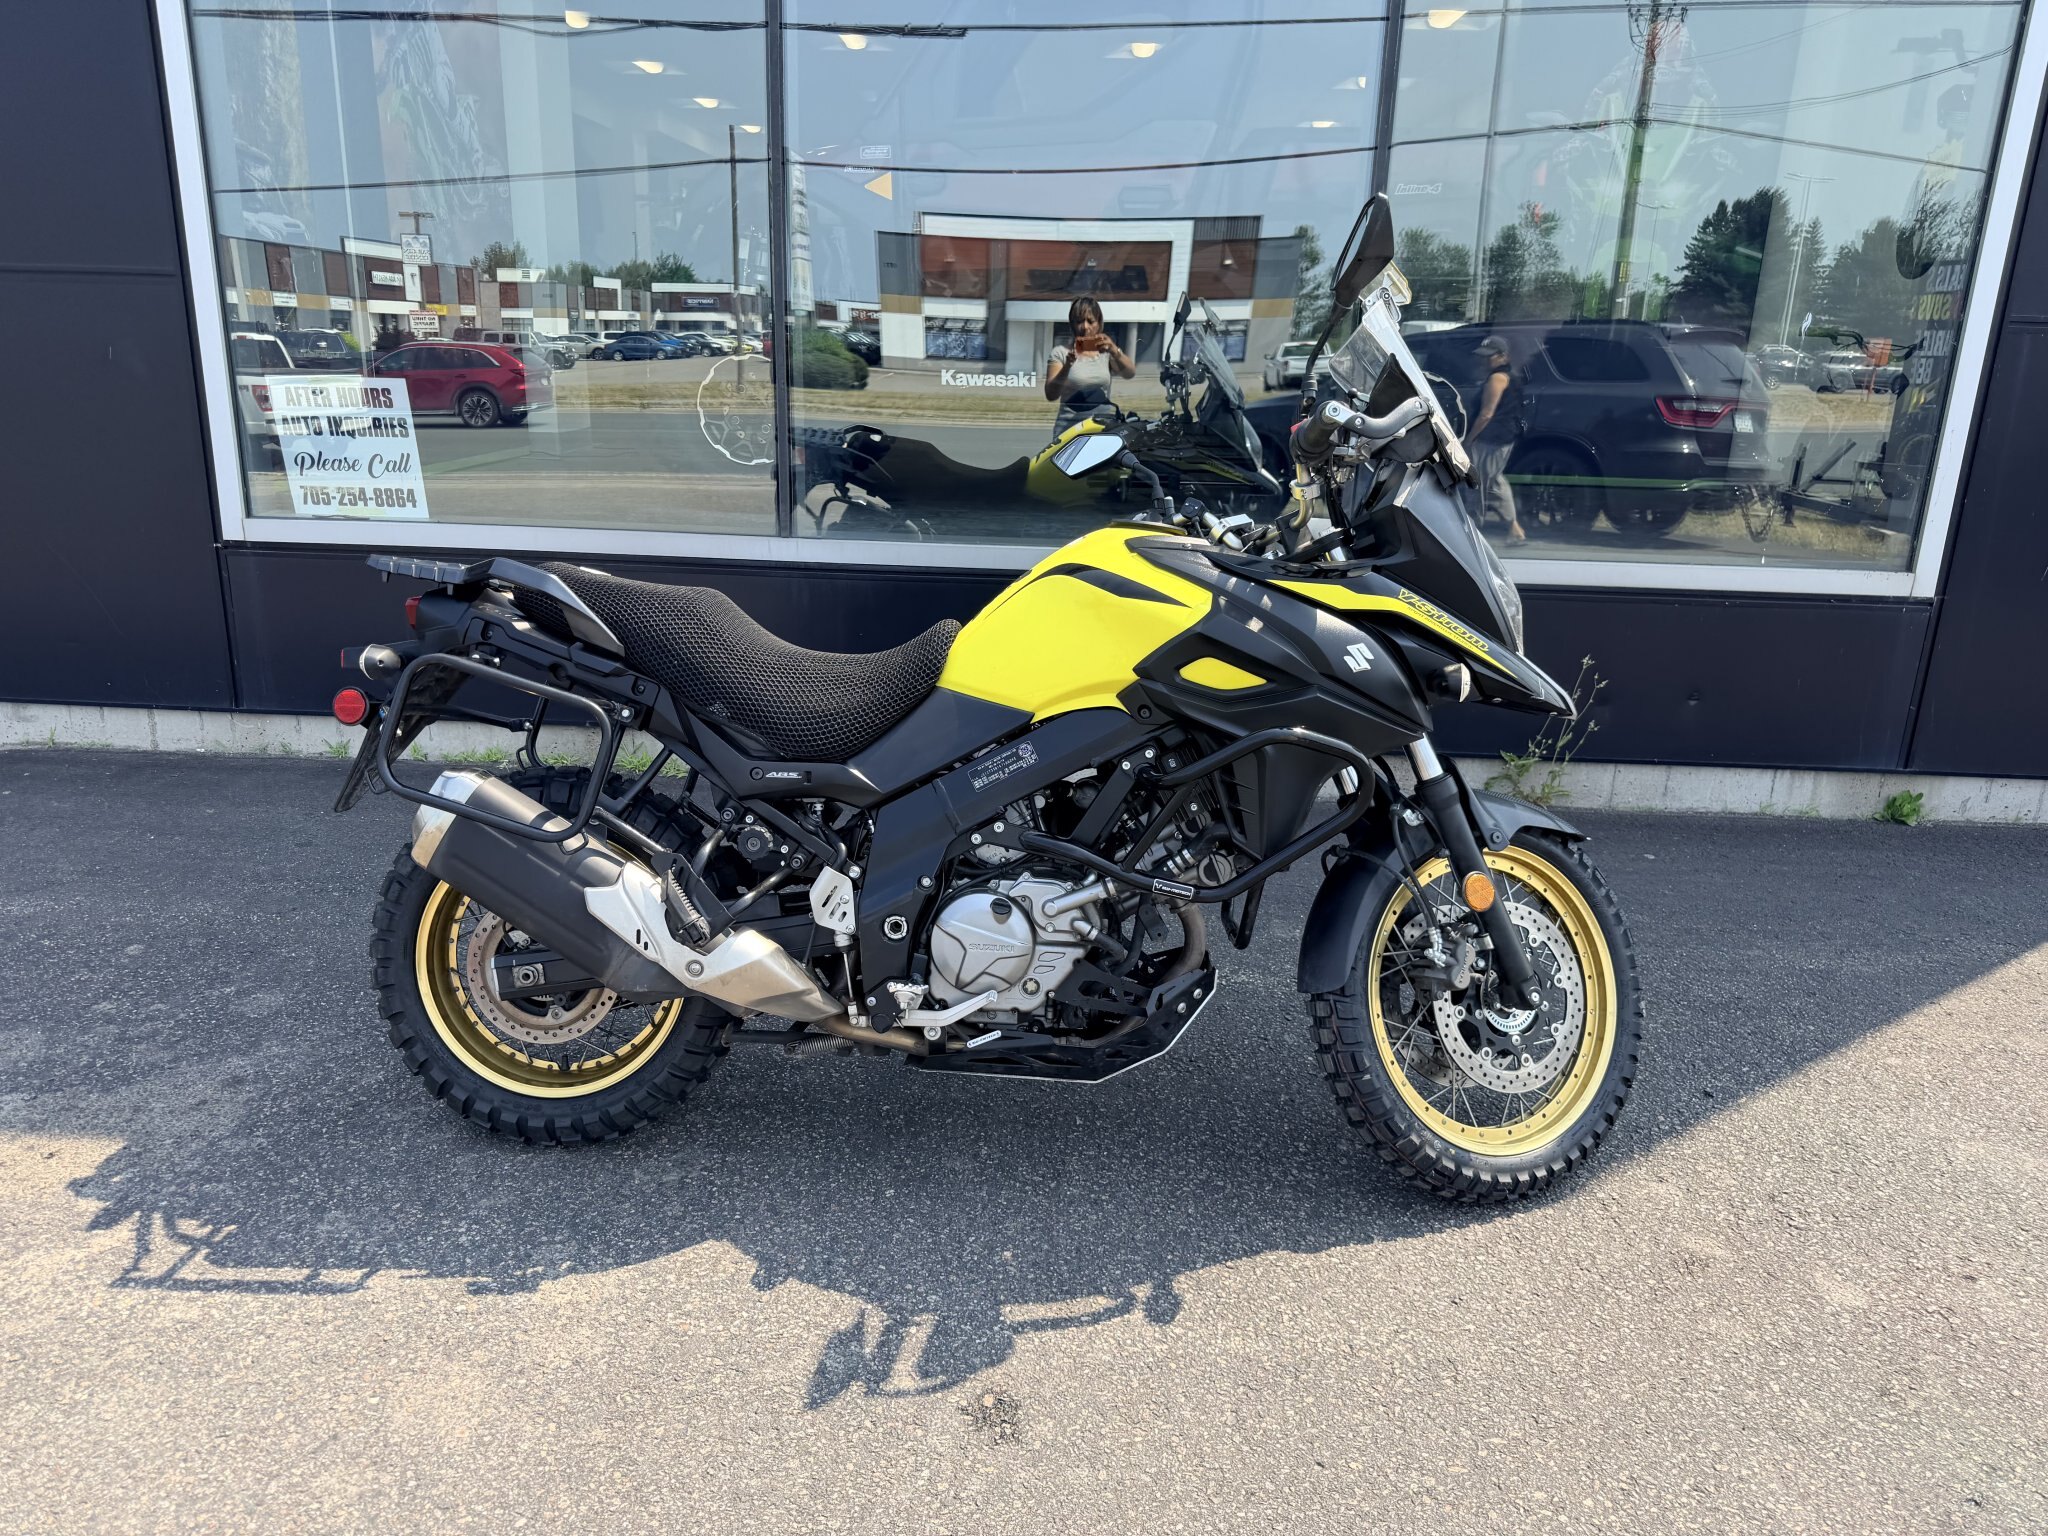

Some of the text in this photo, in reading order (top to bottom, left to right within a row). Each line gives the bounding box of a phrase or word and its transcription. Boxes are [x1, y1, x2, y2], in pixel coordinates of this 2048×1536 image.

[941, 369, 1037, 388] Kawasaki
[284, 386, 394, 409] AFTER HOURS
[281, 415, 410, 440] AUTO INQUIRIES
[294, 451, 412, 479] Please Call
[299, 486, 417, 509] 705-254-8864
[1399, 588, 1490, 652] V-Strom
[968, 943, 1015, 953] SUZUKI
